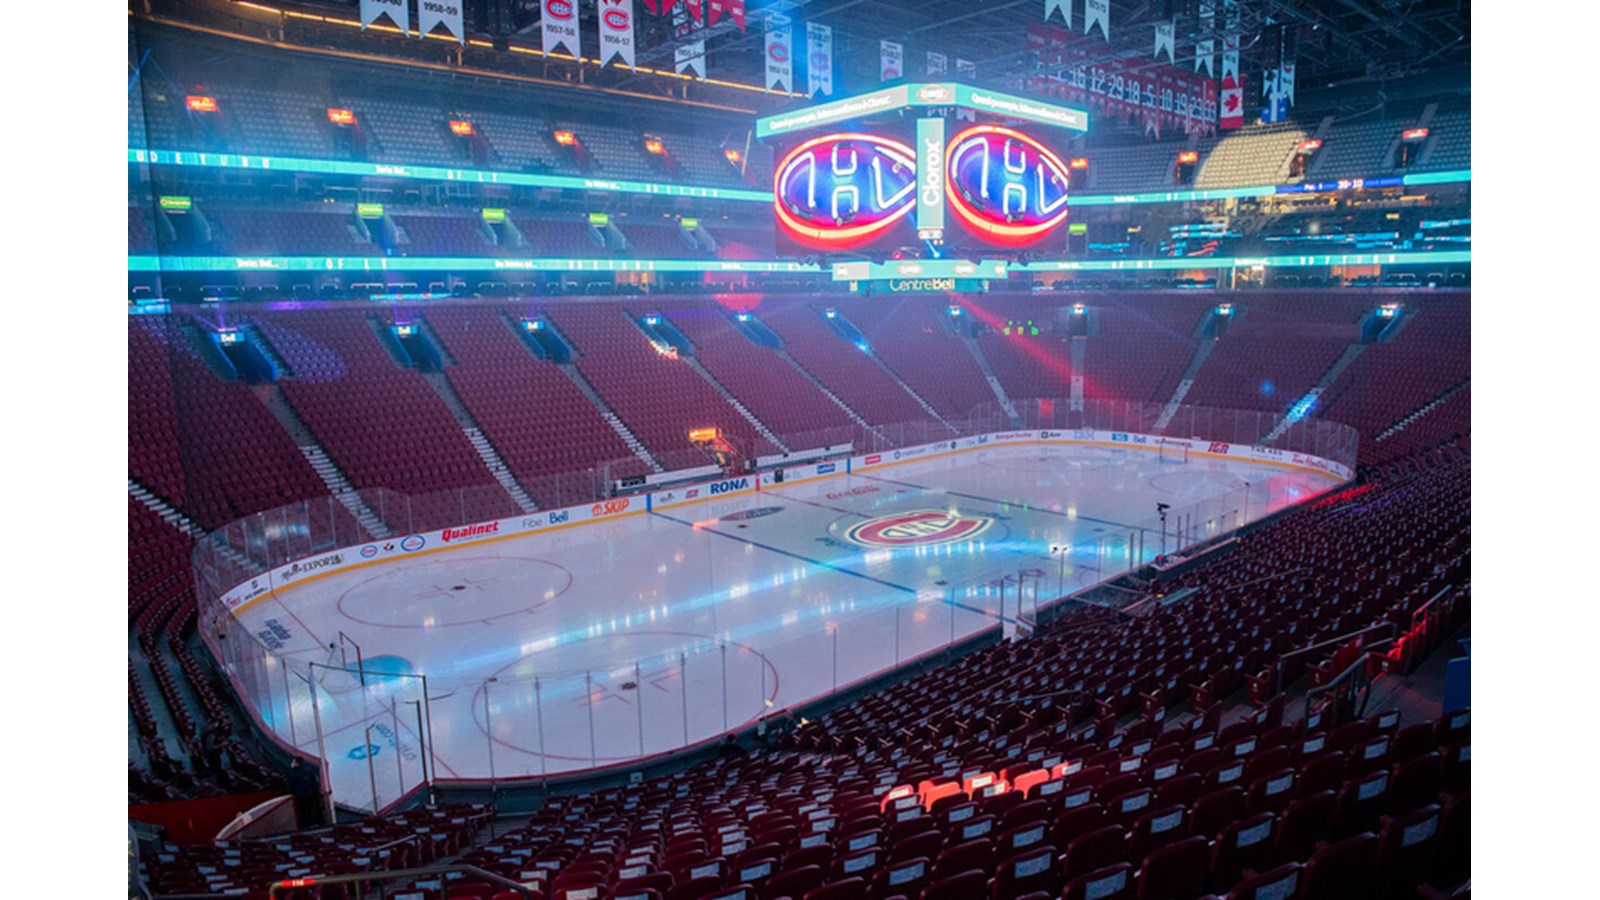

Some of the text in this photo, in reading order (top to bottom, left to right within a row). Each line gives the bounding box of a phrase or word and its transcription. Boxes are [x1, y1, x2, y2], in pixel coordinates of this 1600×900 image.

[423, 1, 459, 16] 1958-59
[546, 23, 575, 37] 1957-58
[603, 34, 630, 46] 1956-57
[1090, 67, 1106, 94] 12
[1107, 73, 1124, 100] 29
[1125, 79, 1140, 105] 18
[1160, 88, 1173, 111] 10
[1174, 92, 1188, 115] 19
[922, 138, 941, 207] Clorox
[1208, 443, 1229, 454] IGA
[711, 479, 749, 494] RONA
[603, 498, 629, 515] SKIP
[522, 511, 568, 528] Fibe Bell
[442, 521, 499, 542] Qualinet
